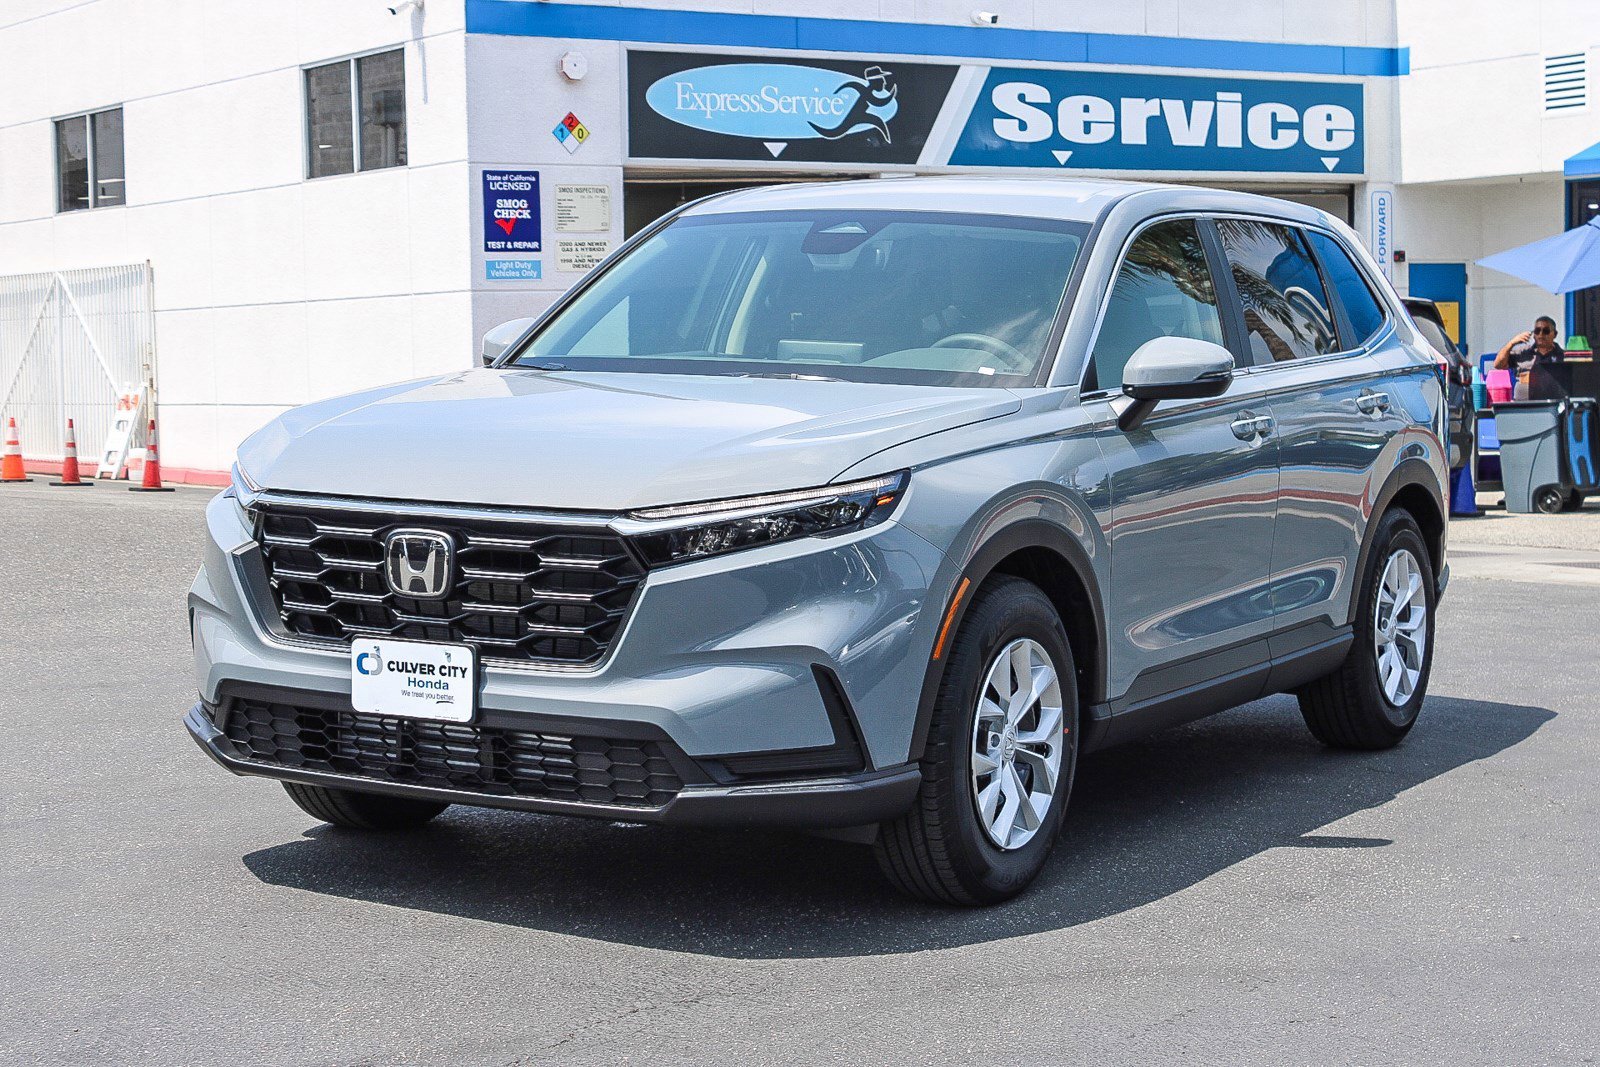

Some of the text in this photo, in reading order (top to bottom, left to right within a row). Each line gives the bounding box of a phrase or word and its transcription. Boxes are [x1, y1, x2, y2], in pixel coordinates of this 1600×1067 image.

[567, 116, 574, 127] 2
[991, 81, 1355, 151] Service
[559, 128, 564, 138] 1
[577, 128, 584, 139] 0
[509, 174, 536, 182] California
[489, 181, 531, 191] LICENSED
[496, 198, 528, 208] SMOG
[493, 208, 531, 219] CHECK
[1378, 197, 1387, 264] FORWARD
[486, 241, 540, 249] TEST & REPAIR
[495, 261, 532, 270] Light Duty
[490, 269, 538, 278] Vehicles Only
[387, 660, 468, 679] CULVER CITY
[407, 676, 449, 690] Honda
[401, 689, 411, 697] We
[411, 691, 425, 699] treat
[425, 692, 436, 700] you
